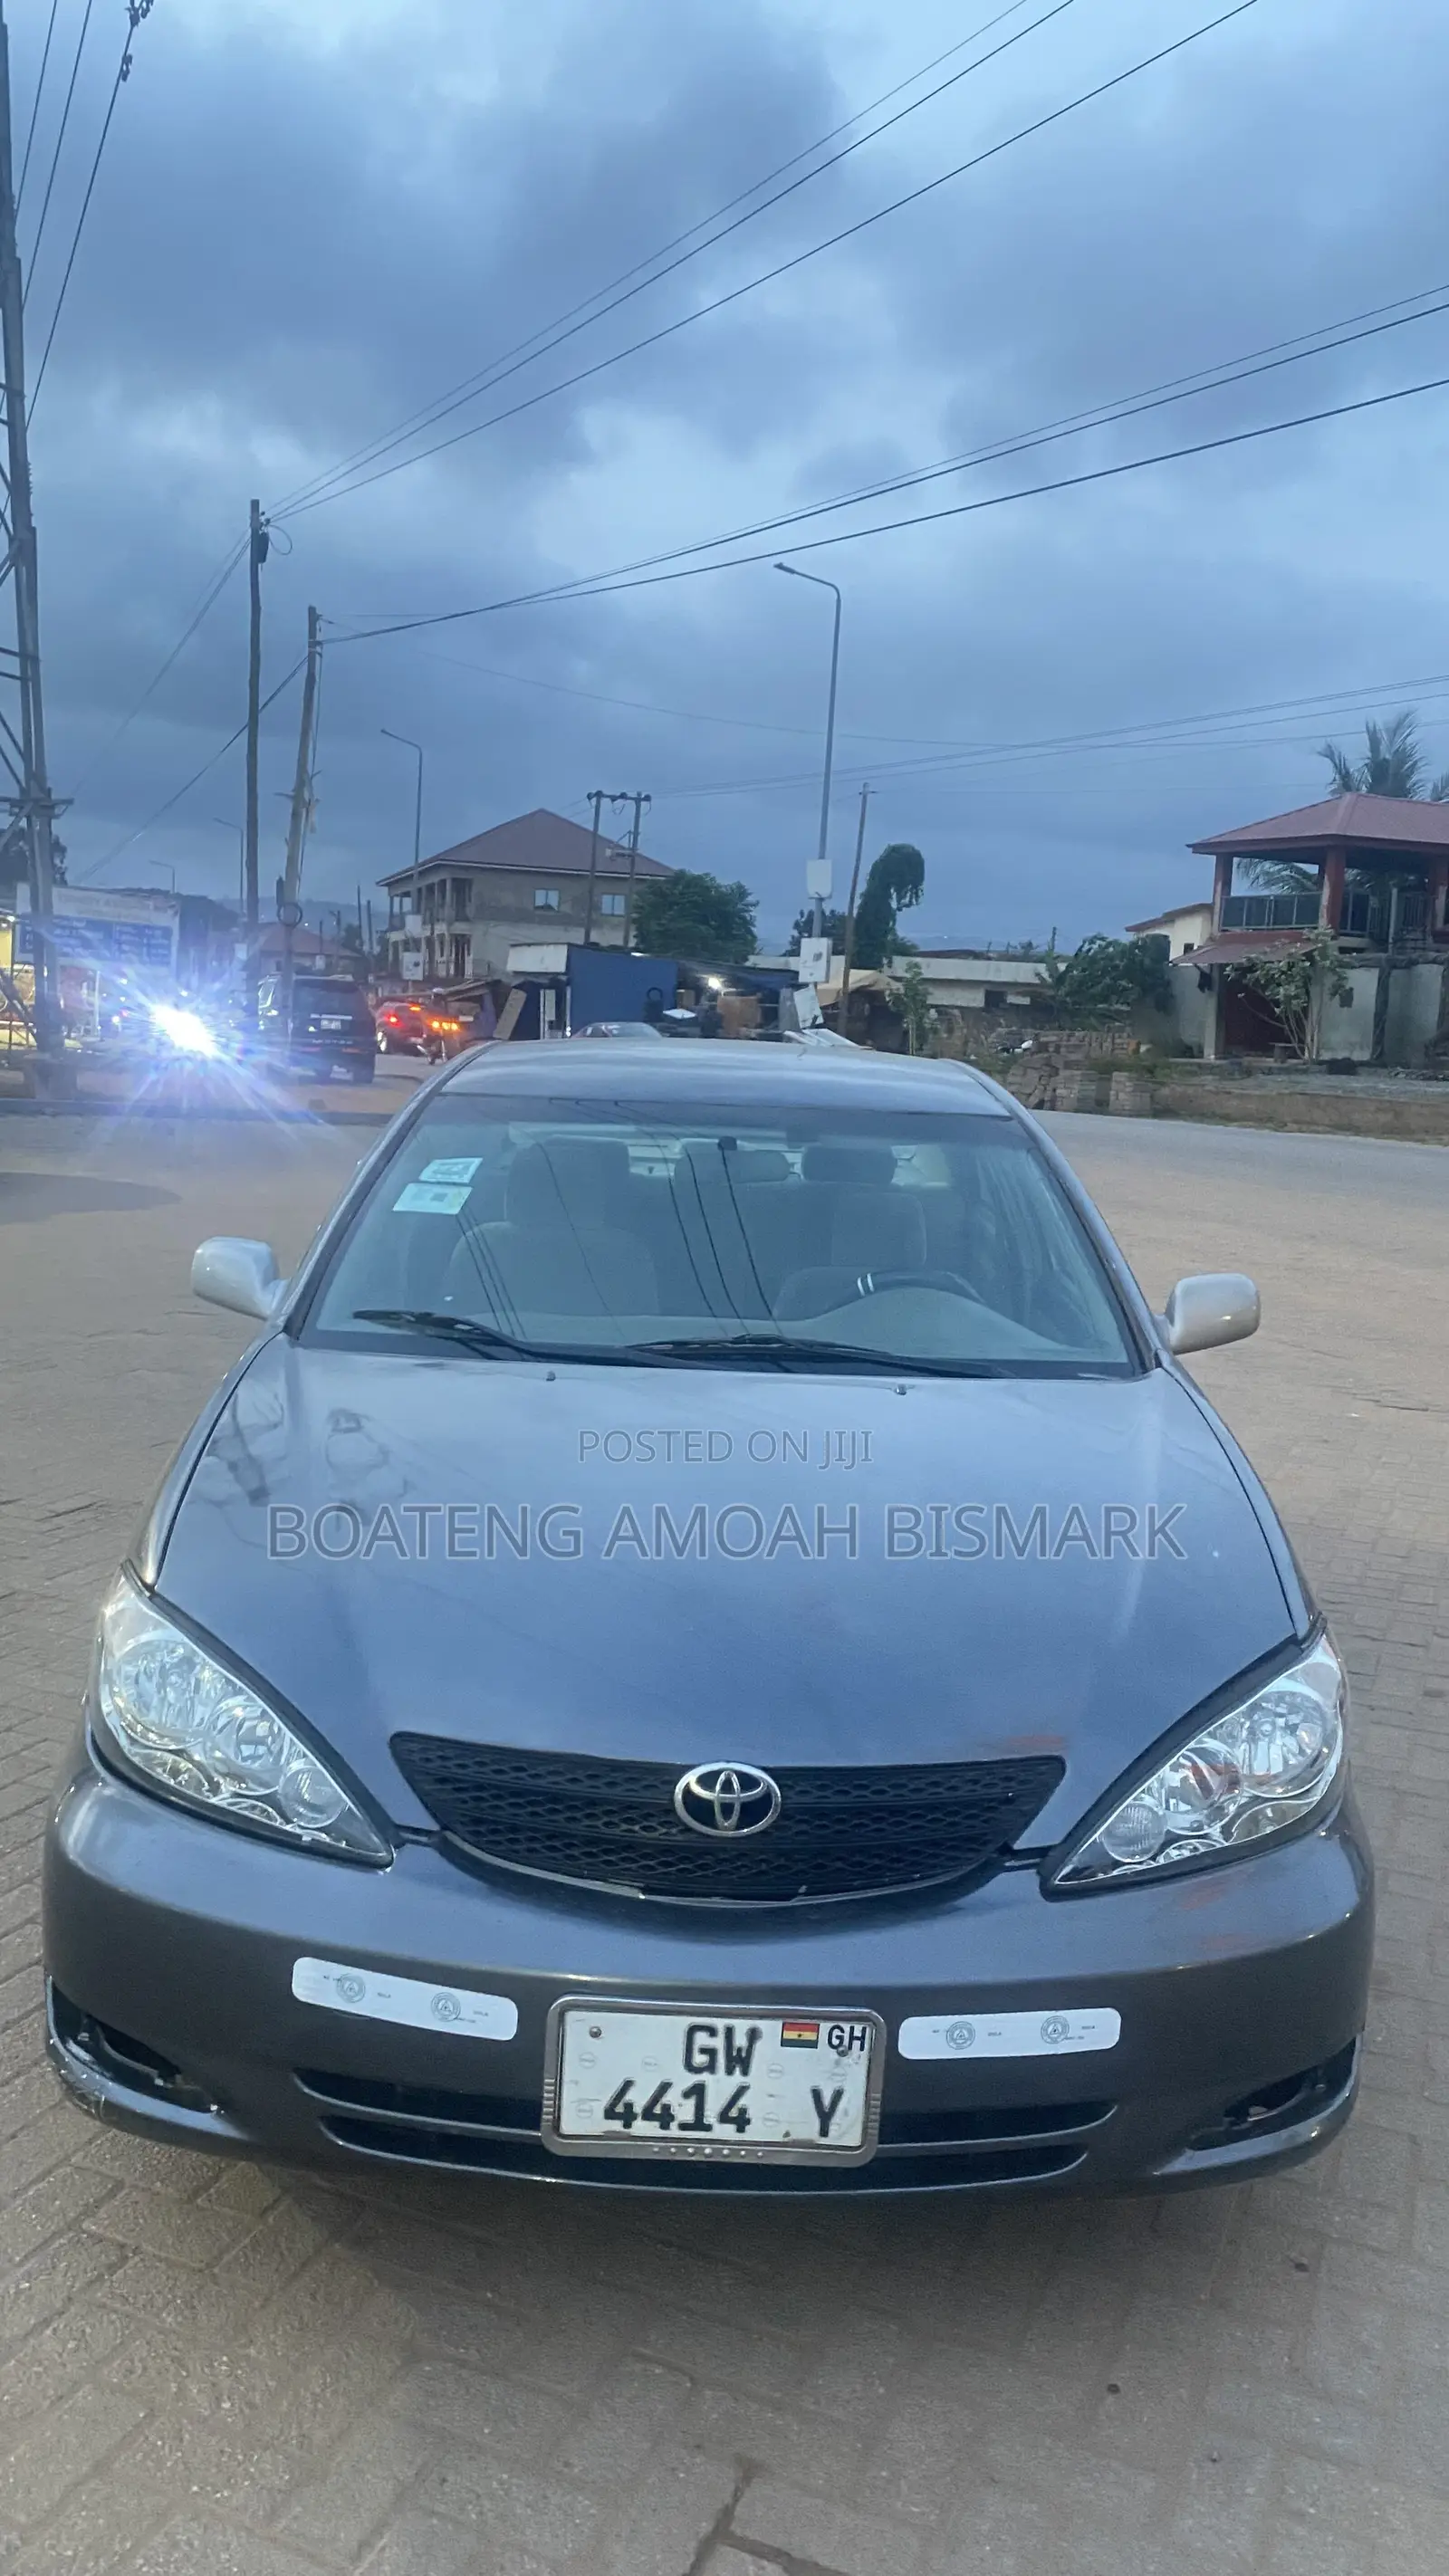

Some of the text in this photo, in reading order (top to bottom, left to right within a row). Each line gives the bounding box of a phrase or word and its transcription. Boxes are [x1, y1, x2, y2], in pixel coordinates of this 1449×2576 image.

[684, 2023, 763, 2076] GW
[827, 2024, 867, 2052] GH
[603, 2078, 844, 2138] 4414 Y
